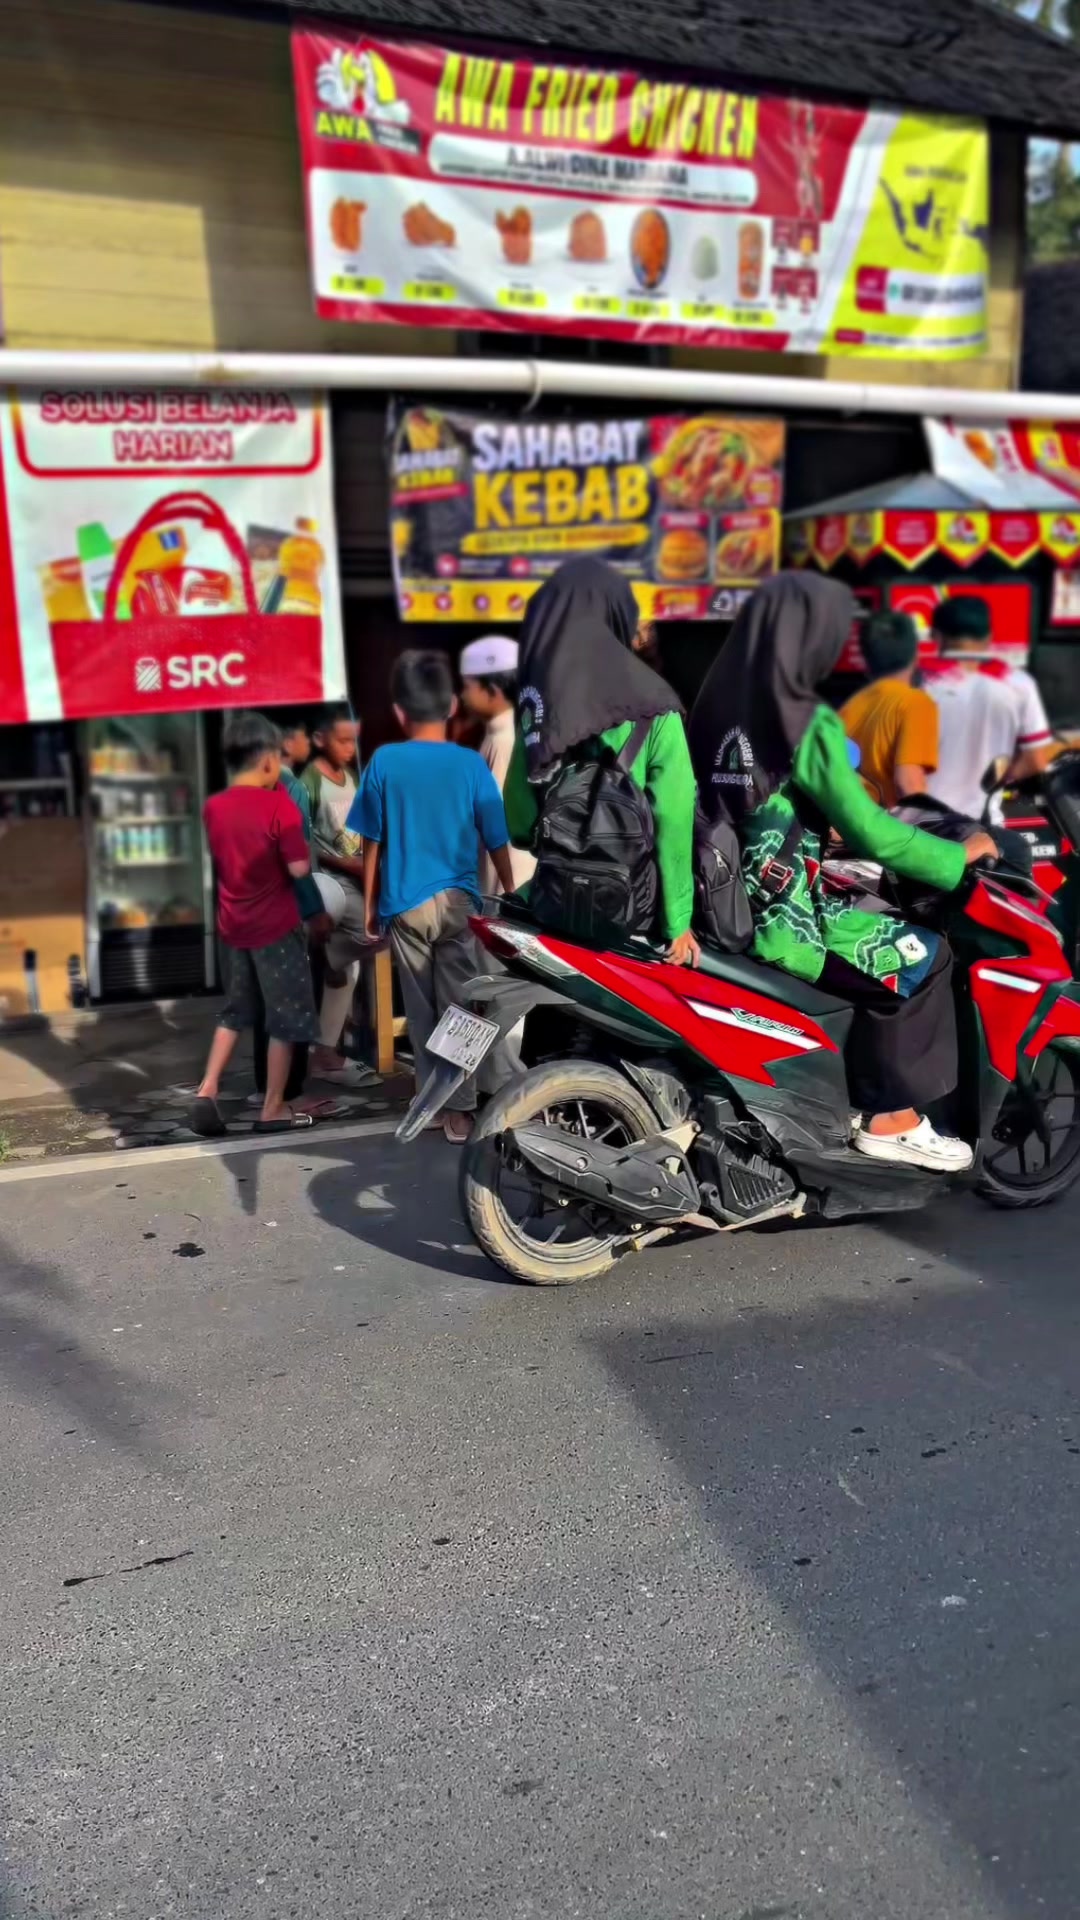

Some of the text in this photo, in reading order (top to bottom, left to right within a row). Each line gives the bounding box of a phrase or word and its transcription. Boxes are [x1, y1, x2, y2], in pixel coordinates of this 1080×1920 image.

[435, 51, 758, 160] AWA FRIED CHICKEN
[316, 110, 374, 143] AWA
[41, 390, 297, 424] SOLUSI BELANJA
[113, 429, 234, 462] HARIAN
[473, 419, 646, 471] SAHABAT
[473, 464, 651, 529] KEBAB
[166, 651, 247, 689] SRC
